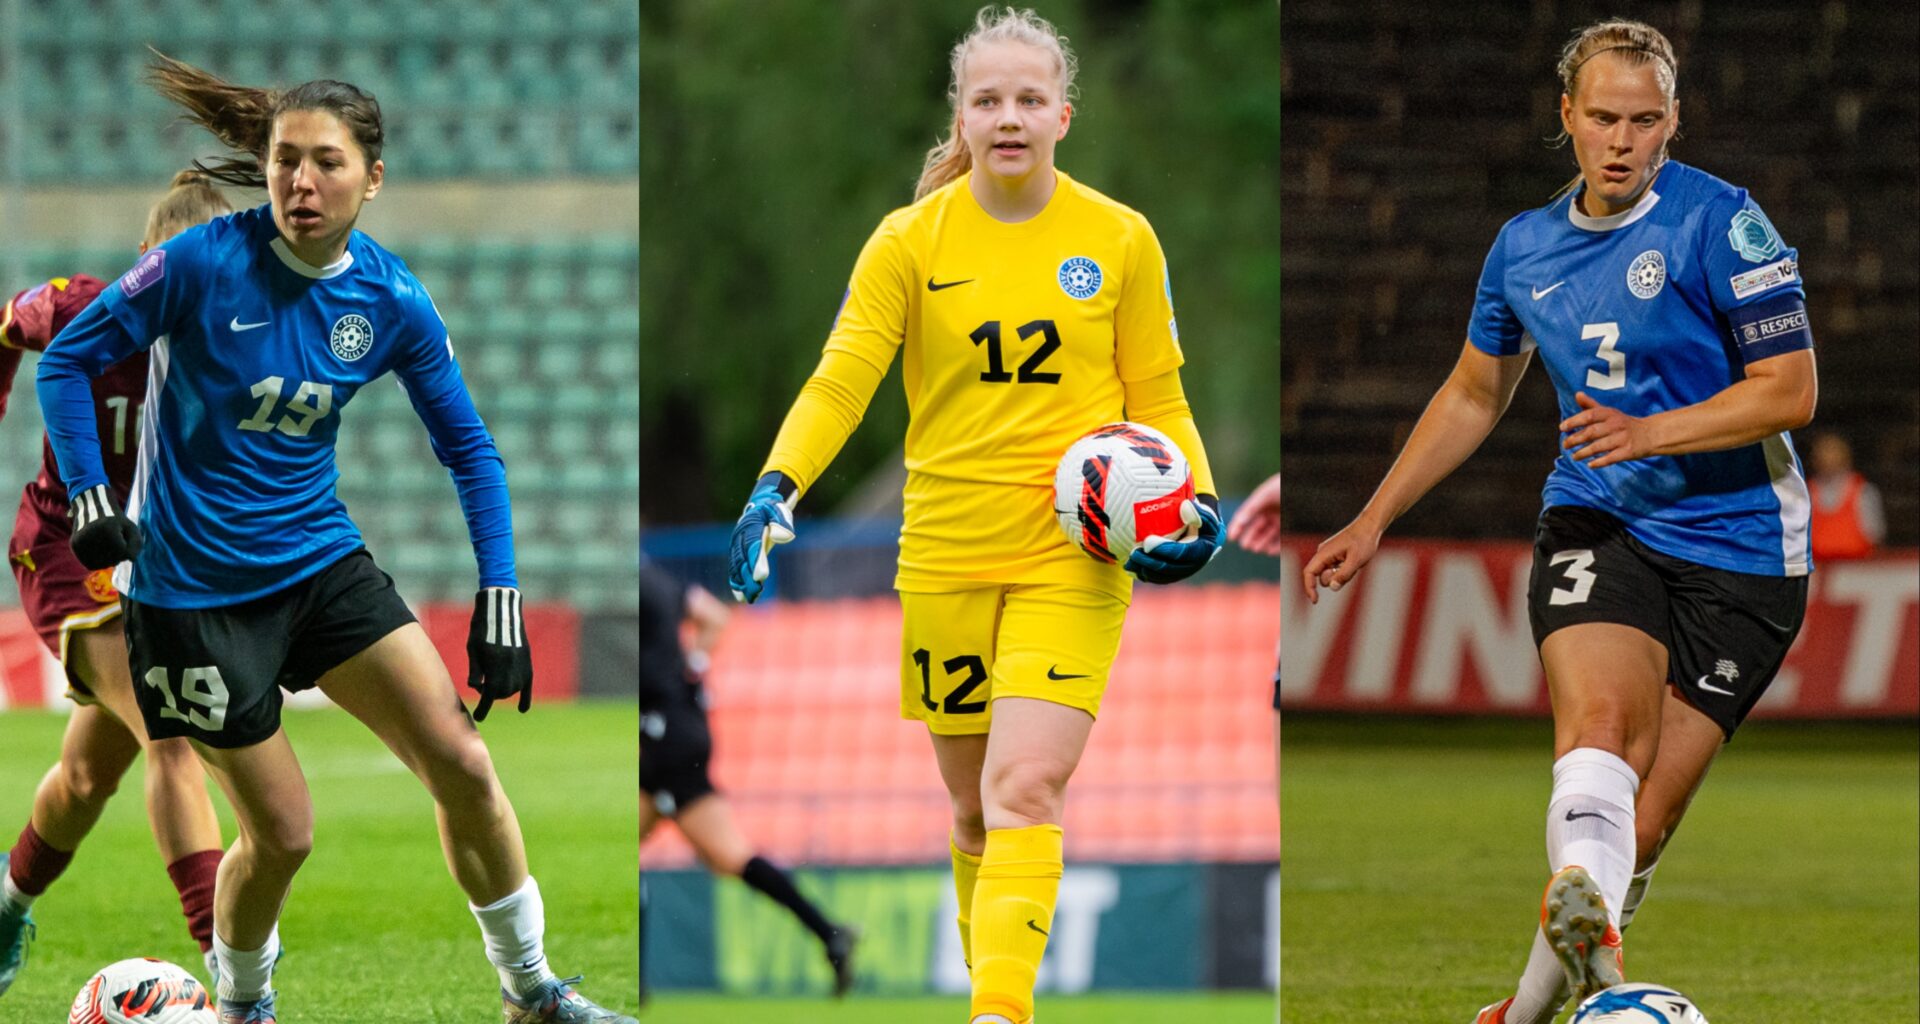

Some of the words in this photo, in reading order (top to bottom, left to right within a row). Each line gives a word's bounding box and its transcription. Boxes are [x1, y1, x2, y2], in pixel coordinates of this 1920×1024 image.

[333, 329, 361, 359] JALGPALLI
[360, 332, 371, 351] LIIT
[342, 316, 367, 329] EESTI
[968, 319, 1062, 385] 12
[1760, 314, 1806, 335] RESPECT
[1580, 322, 1626, 390] 3
[237, 376, 332, 436] 19
[1548, 549, 1597, 606] 3
[144, 666, 230, 731] 19
[912, 648, 988, 714] 12
